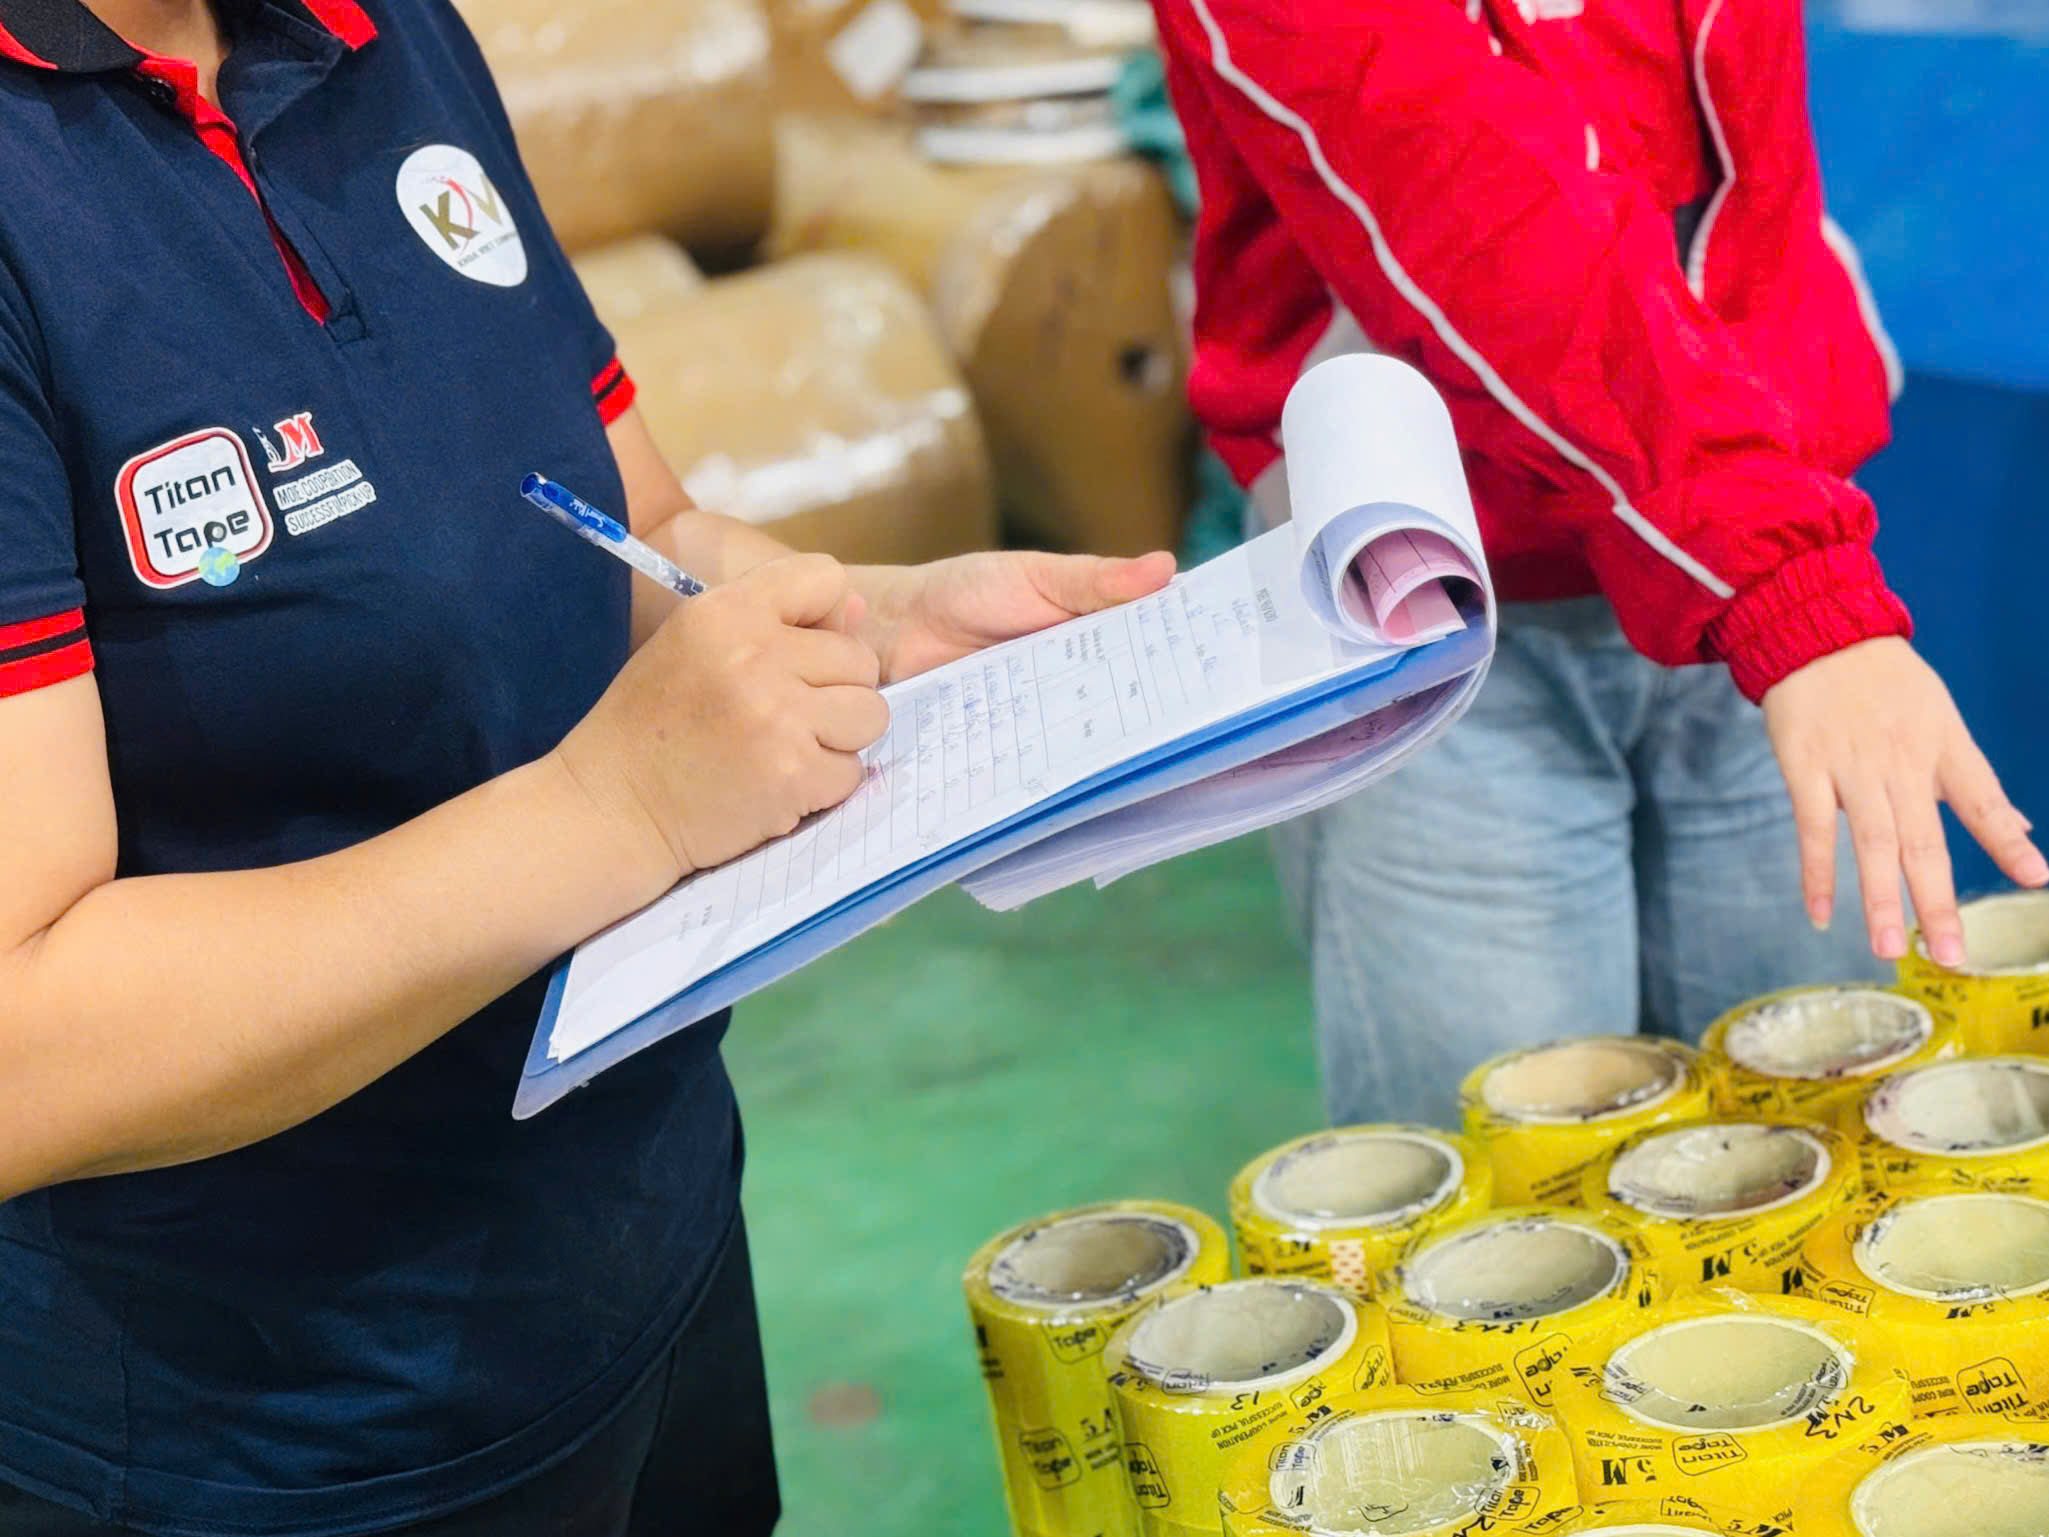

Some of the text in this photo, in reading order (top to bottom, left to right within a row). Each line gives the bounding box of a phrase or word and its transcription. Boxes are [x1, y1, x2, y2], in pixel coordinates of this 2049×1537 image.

[144, 465, 236, 515] Titan
[154, 509, 250, 558] Tape
[1966, 1370, 2018, 1397] Tape
[1678, 1437, 1735, 1452] Tape
[1681, 1449, 1744, 1465] Titan
